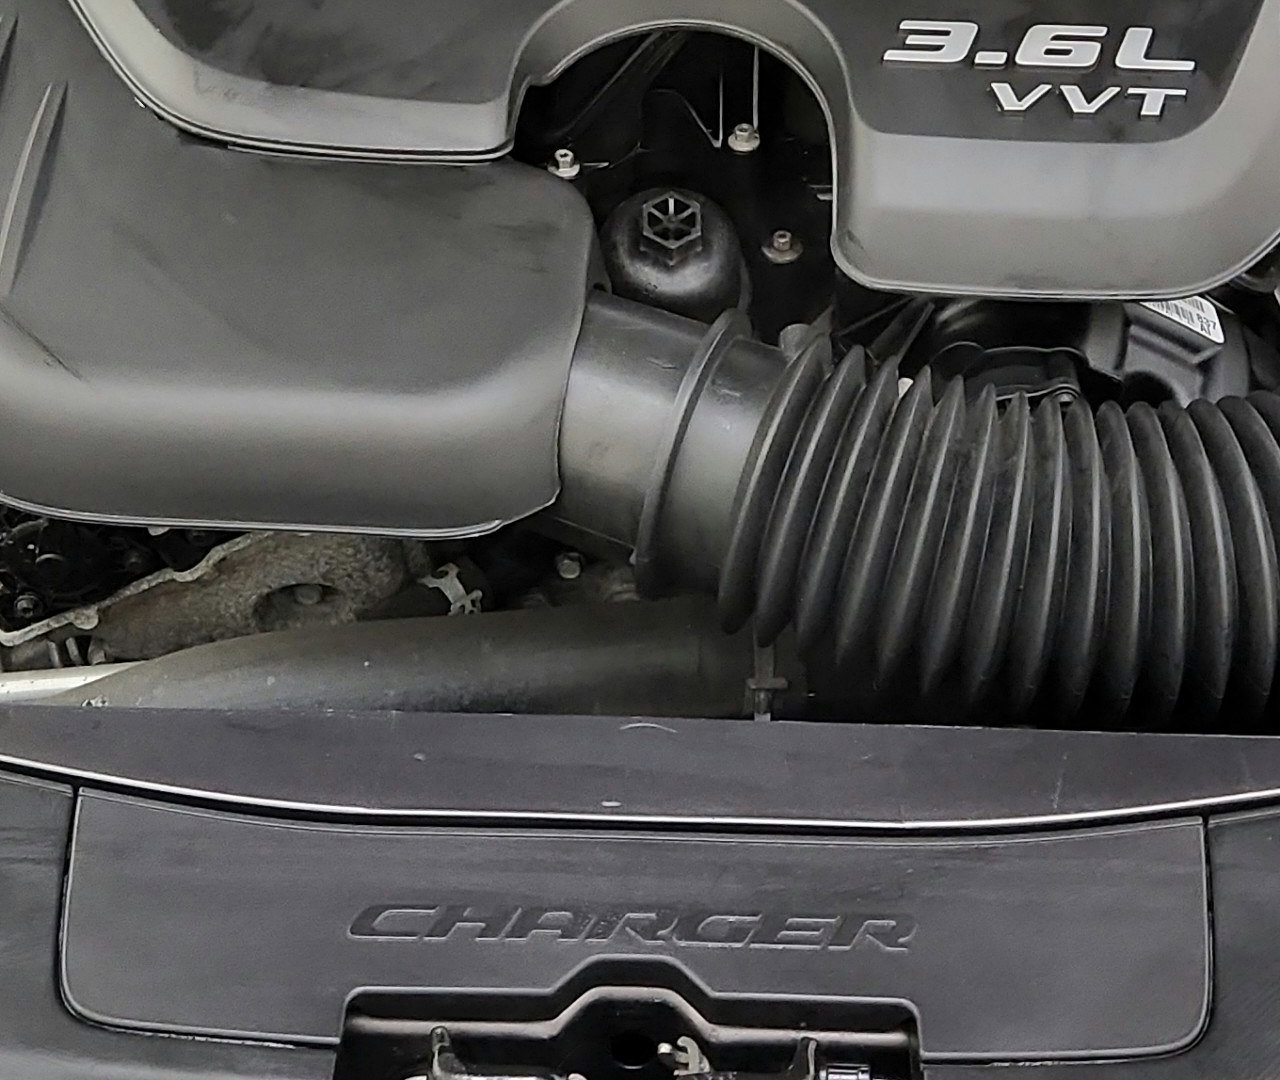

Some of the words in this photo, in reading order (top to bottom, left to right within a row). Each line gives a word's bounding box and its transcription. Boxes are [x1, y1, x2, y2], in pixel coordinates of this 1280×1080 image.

[882, 19, 1196, 71] 3.6L
[990, 82, 1188, 117] VVT
[346, 903, 918, 952] CHARGER
